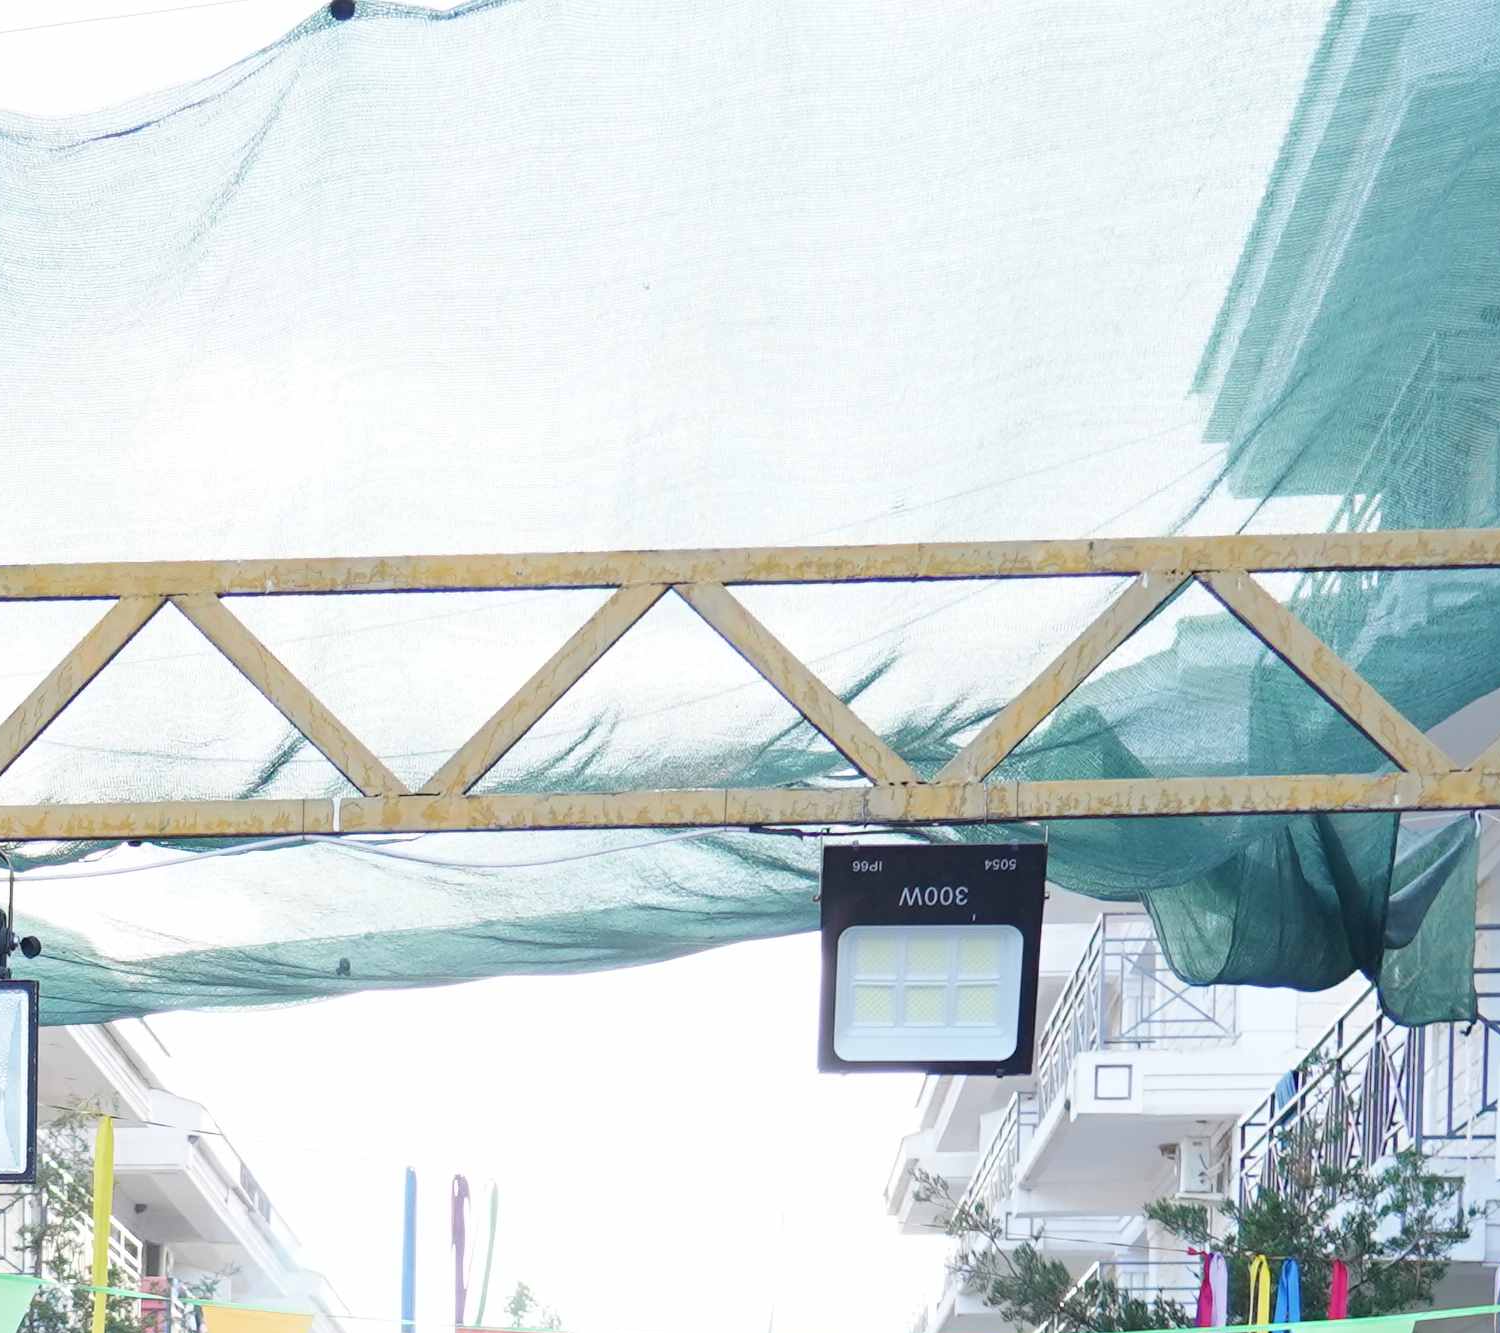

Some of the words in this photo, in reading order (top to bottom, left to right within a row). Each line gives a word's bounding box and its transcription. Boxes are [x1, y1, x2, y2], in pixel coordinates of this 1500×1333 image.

[852, 860, 882, 872] IP66
[984, 858, 1017, 870] 5054
[898, 886, 969, 906] 300W
